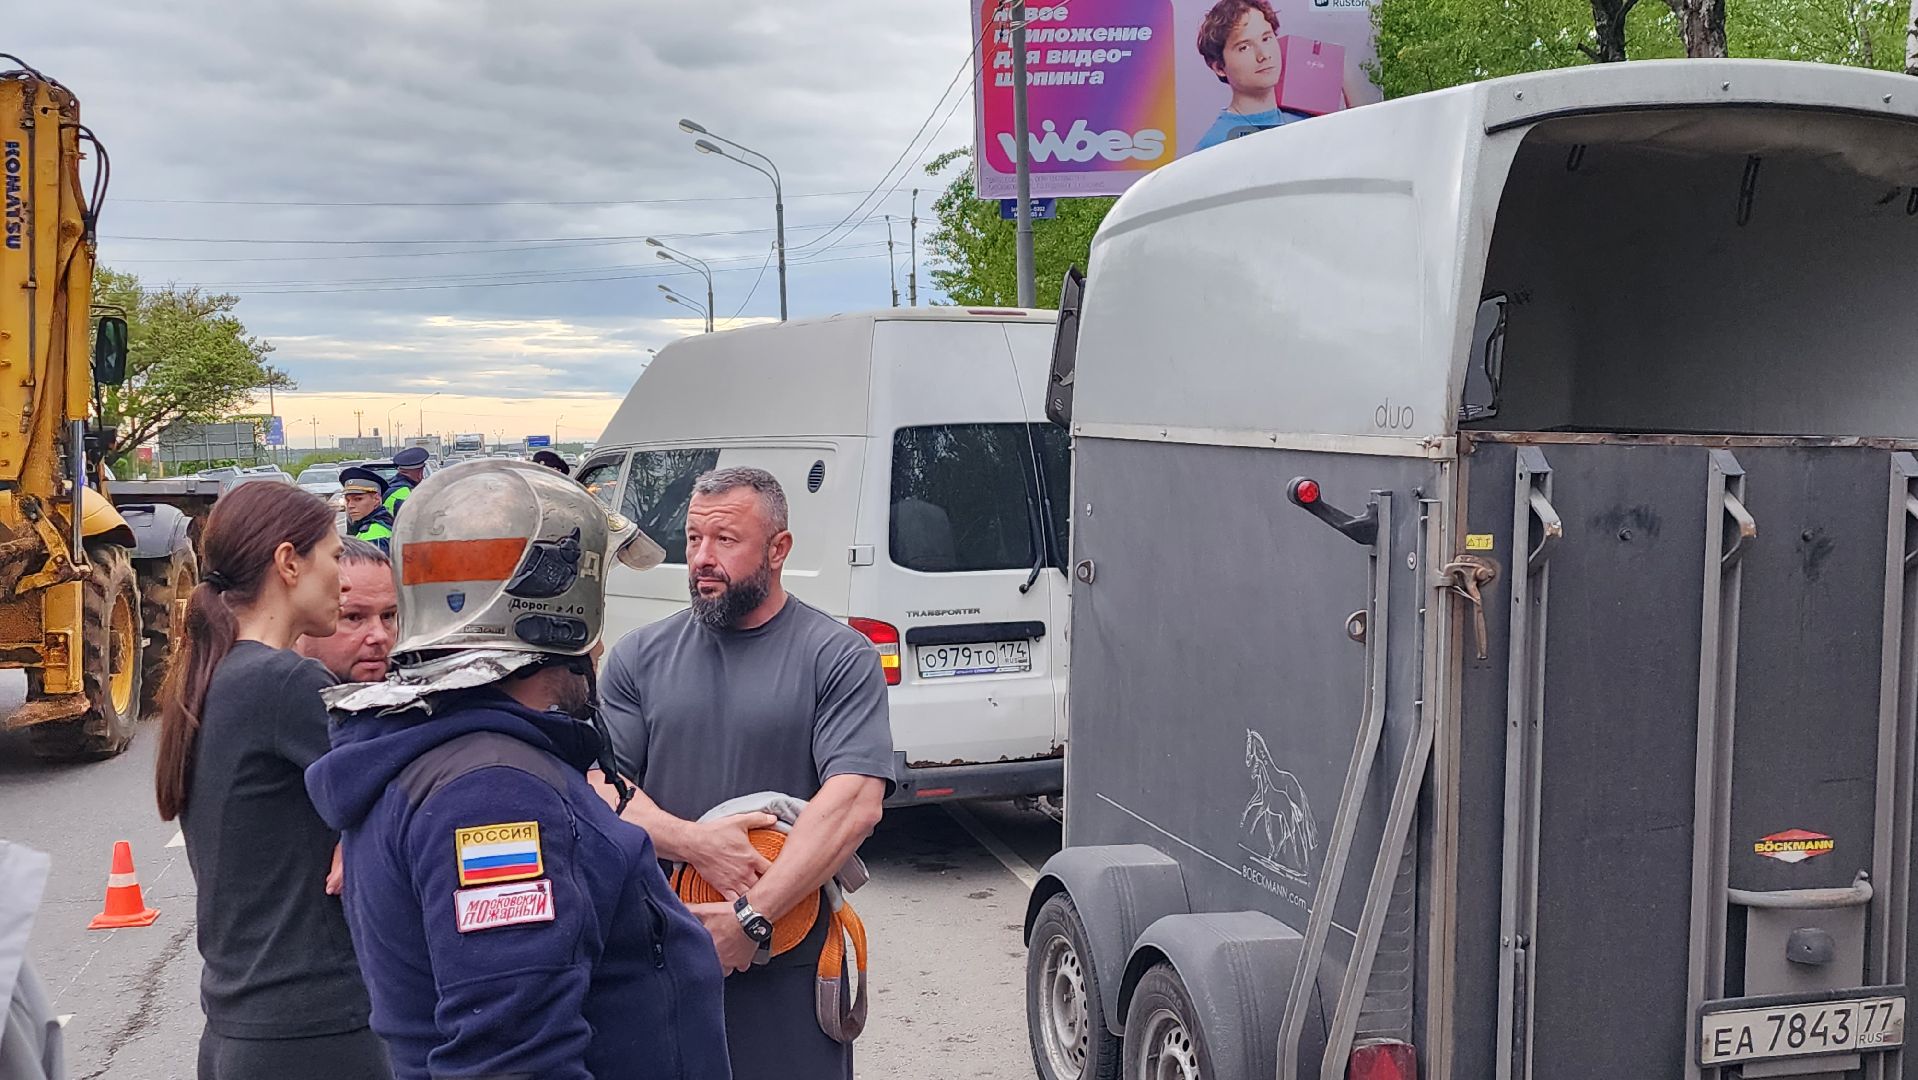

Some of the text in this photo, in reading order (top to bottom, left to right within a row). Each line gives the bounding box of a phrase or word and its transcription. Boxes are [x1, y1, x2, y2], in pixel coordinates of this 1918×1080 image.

[993, 6, 1069, 21] нвое
[993, 49, 1132, 69] дя видео-
[5, 140, 21, 250] KOMATSU
[1375, 397, 1414, 430] duo
[905, 608, 981, 618] TRANSPORTER
[999, 642, 1027, 658] 174
[462, 827, 533, 844] РОССИЯ
[1754, 839, 1834, 853] BÖCKMANN
[1242, 864, 1306, 910] BOECKMANN.com
[1766, 1008, 1851, 1052] 7843
[1863, 1003, 1894, 1033] 77
[1859, 1032, 1883, 1045] RUS
